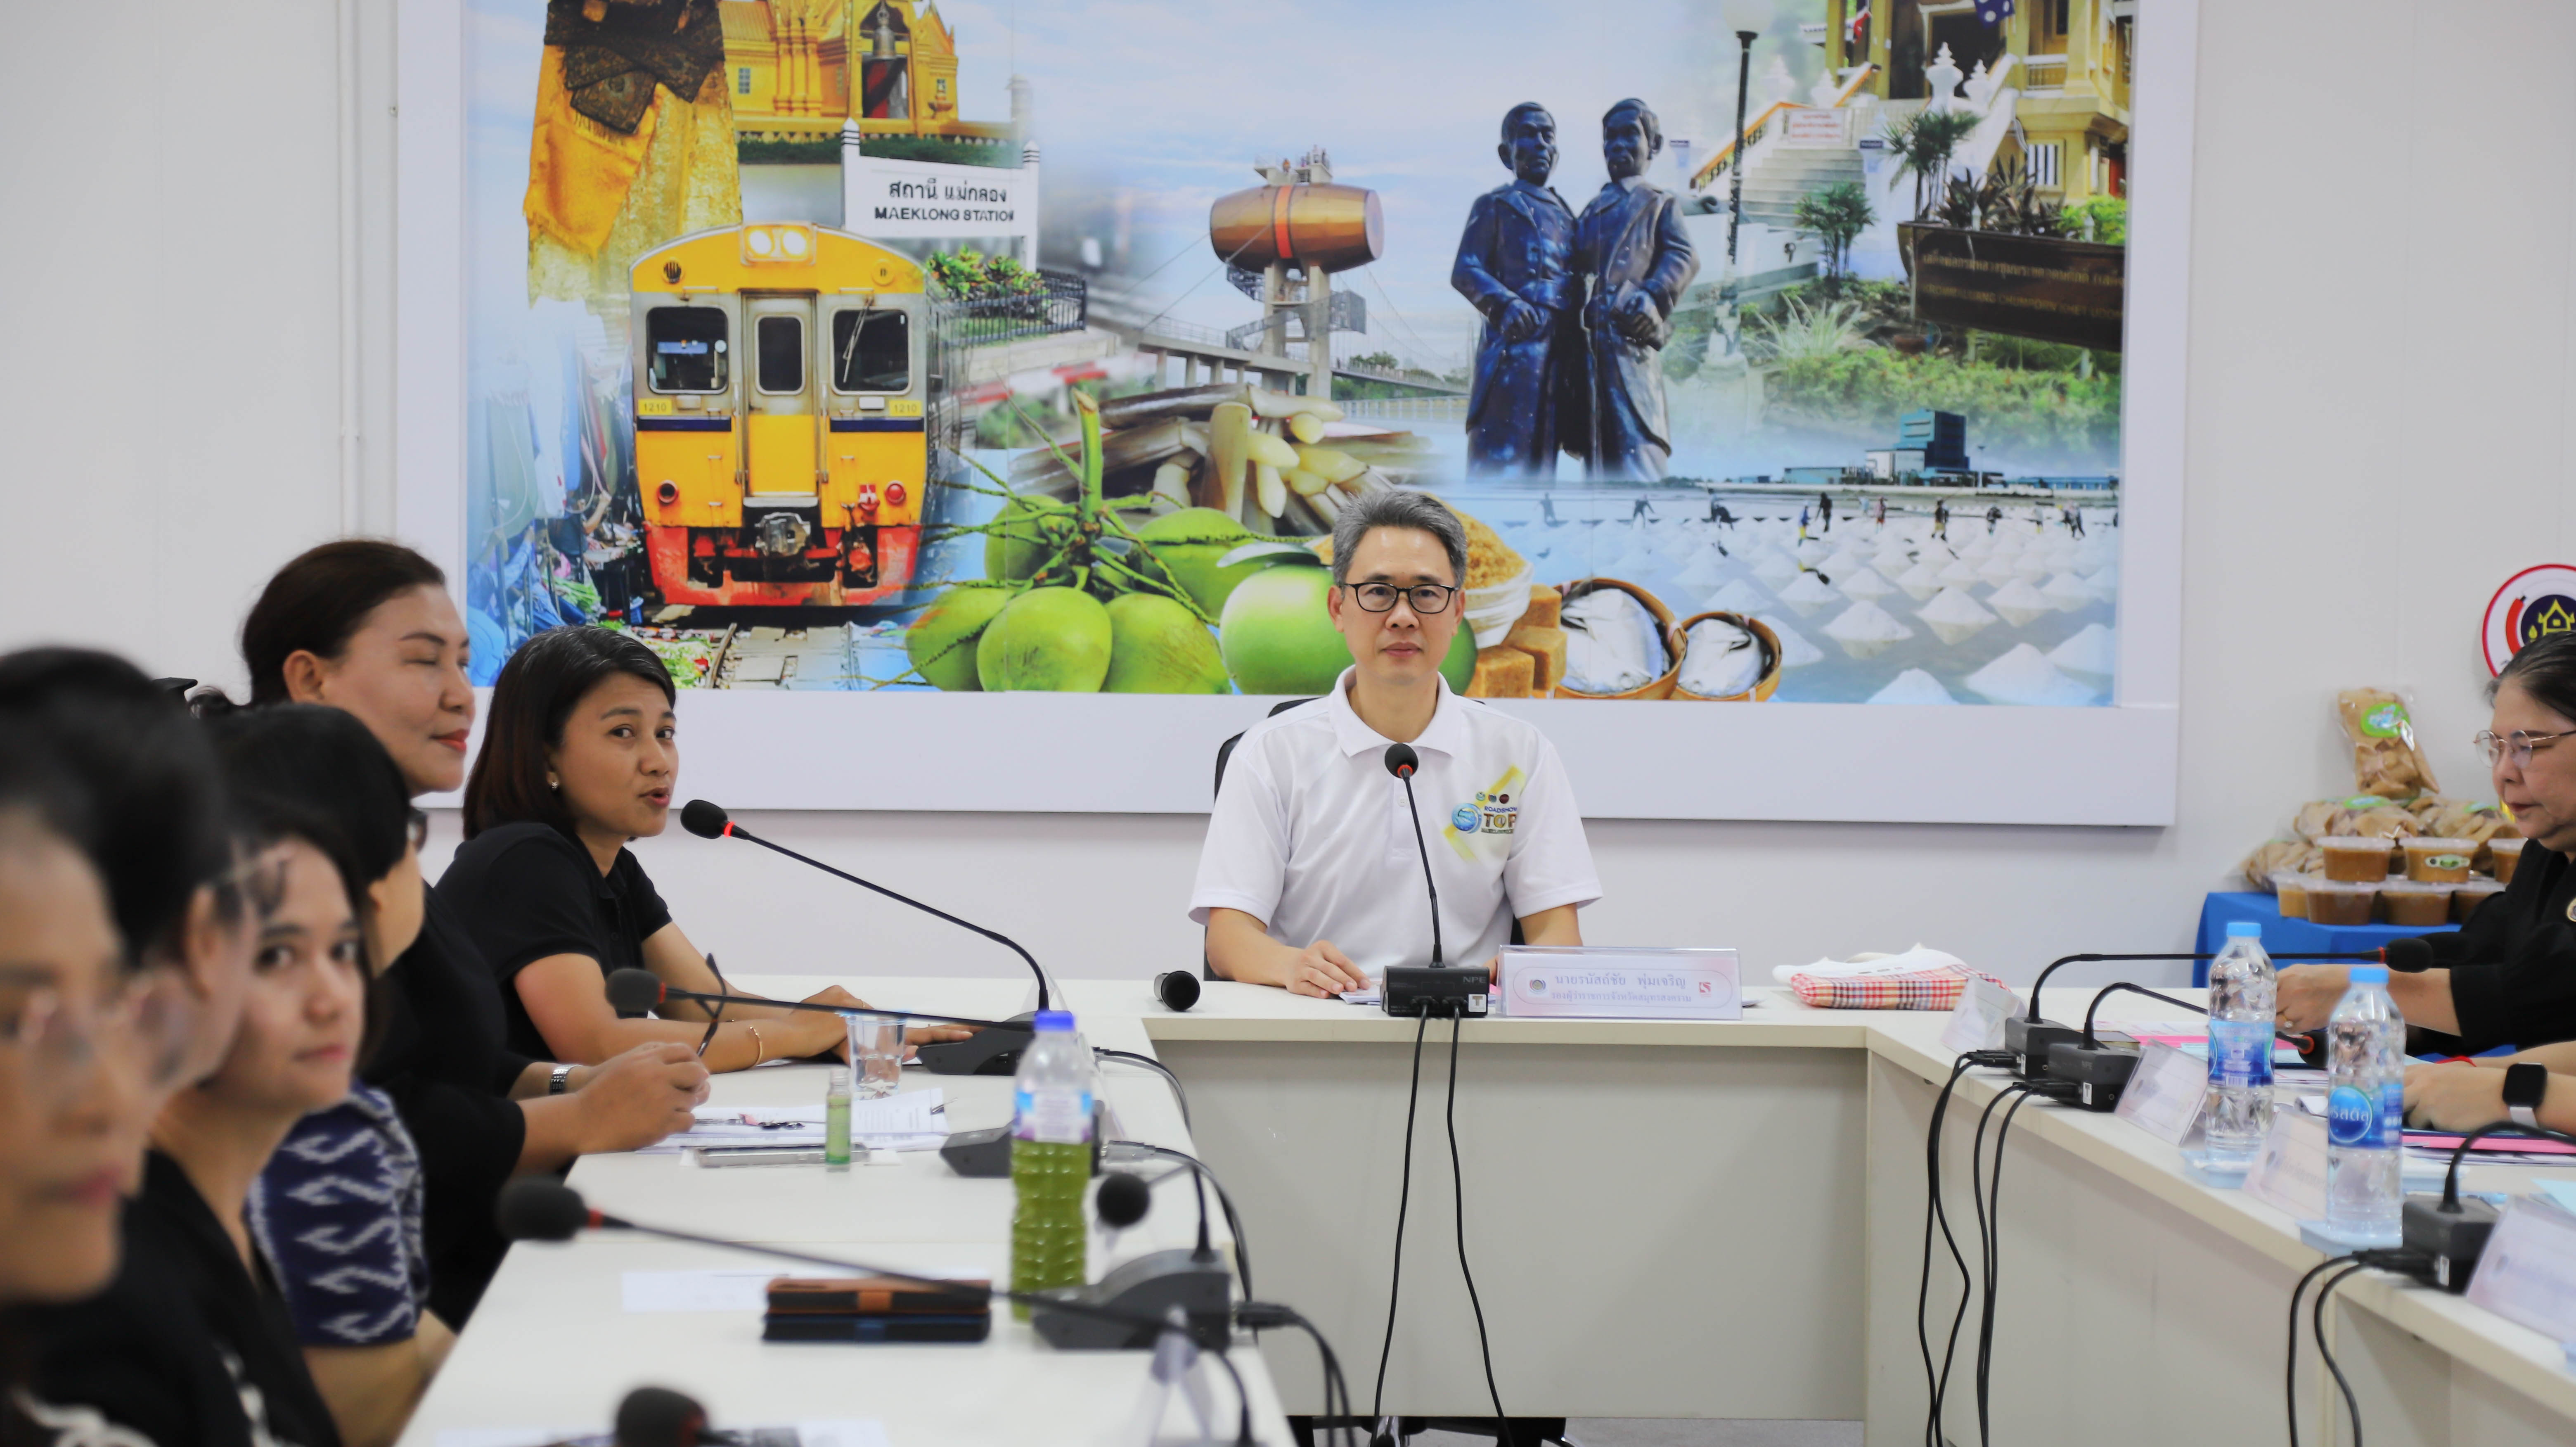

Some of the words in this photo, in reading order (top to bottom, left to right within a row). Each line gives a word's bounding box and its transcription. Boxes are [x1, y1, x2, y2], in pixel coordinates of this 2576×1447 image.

[890, 178, 938, 200] สถานี
[945, 180, 1007, 203] แม่กลอง
[874, 206, 959, 221] MAEKLONG
[964, 210, 1014, 222] STATION
[644, 402, 667, 412] 1210
[895, 403, 918, 413] 1210
